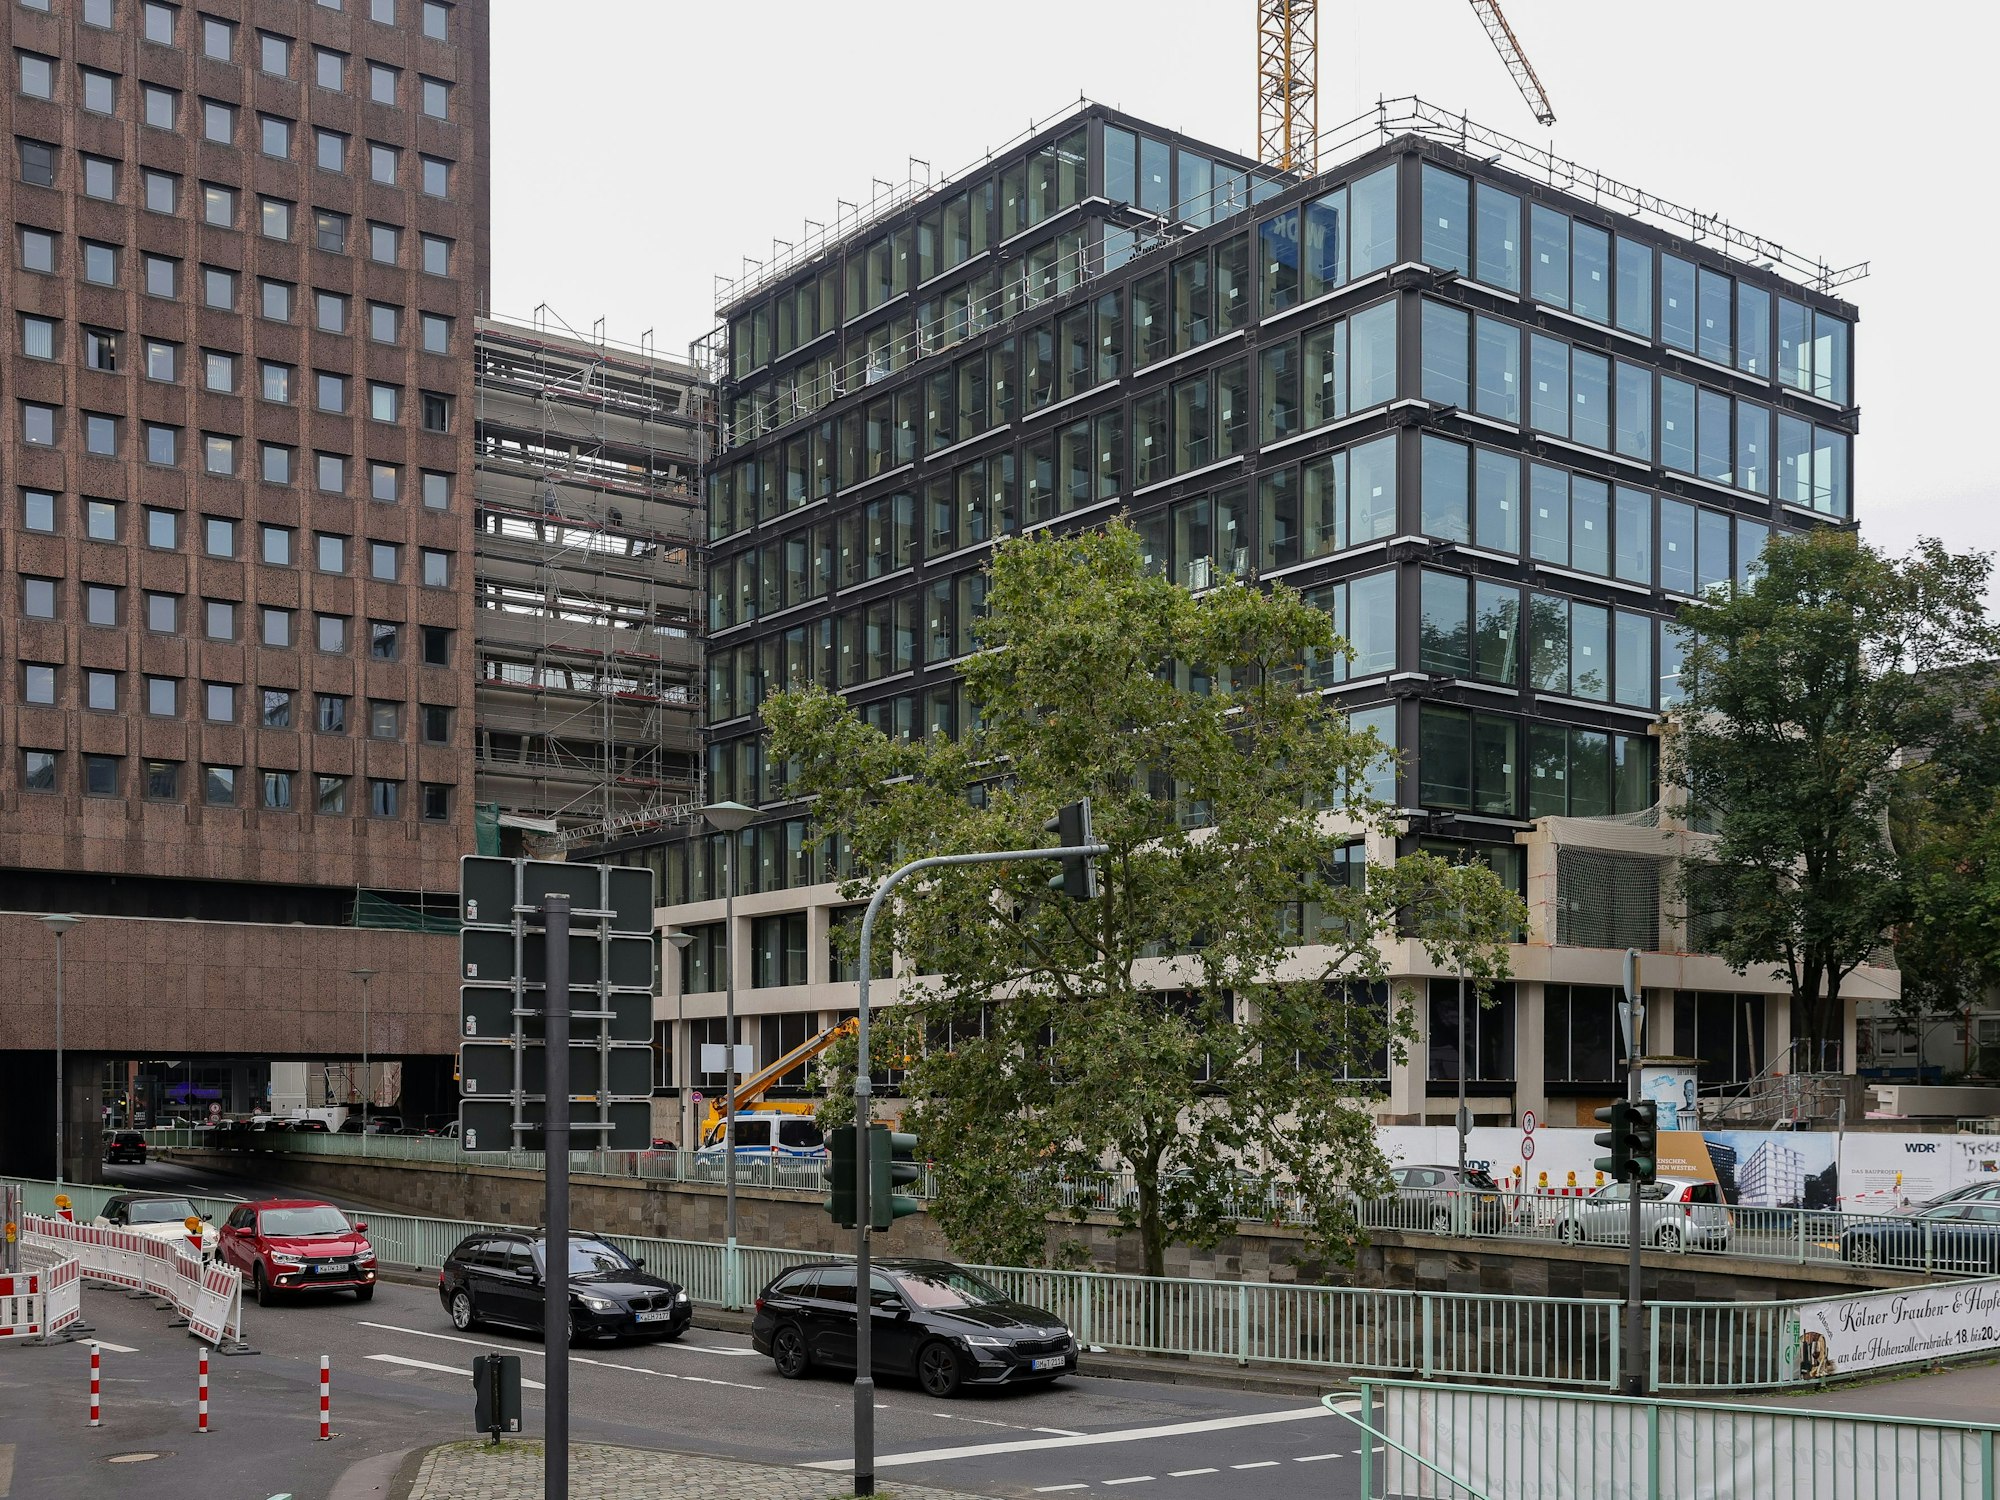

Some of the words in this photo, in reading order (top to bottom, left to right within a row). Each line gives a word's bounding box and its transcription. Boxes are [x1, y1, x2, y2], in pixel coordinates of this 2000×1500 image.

[1905, 1143, 1936, 1153] WDR
[1840, 1301, 1888, 1332] Kölner
[1891, 1296, 1949, 1324] Trauben-
[1952, 1291, 1962, 1313] &
[1837, 1354, 1849, 1363] an
[1851, 1344, 1867, 1361] der
[1867, 1331, 1953, 1361] Hohenzollernbrücke
[1970, 1327, 1982, 1342] bis
